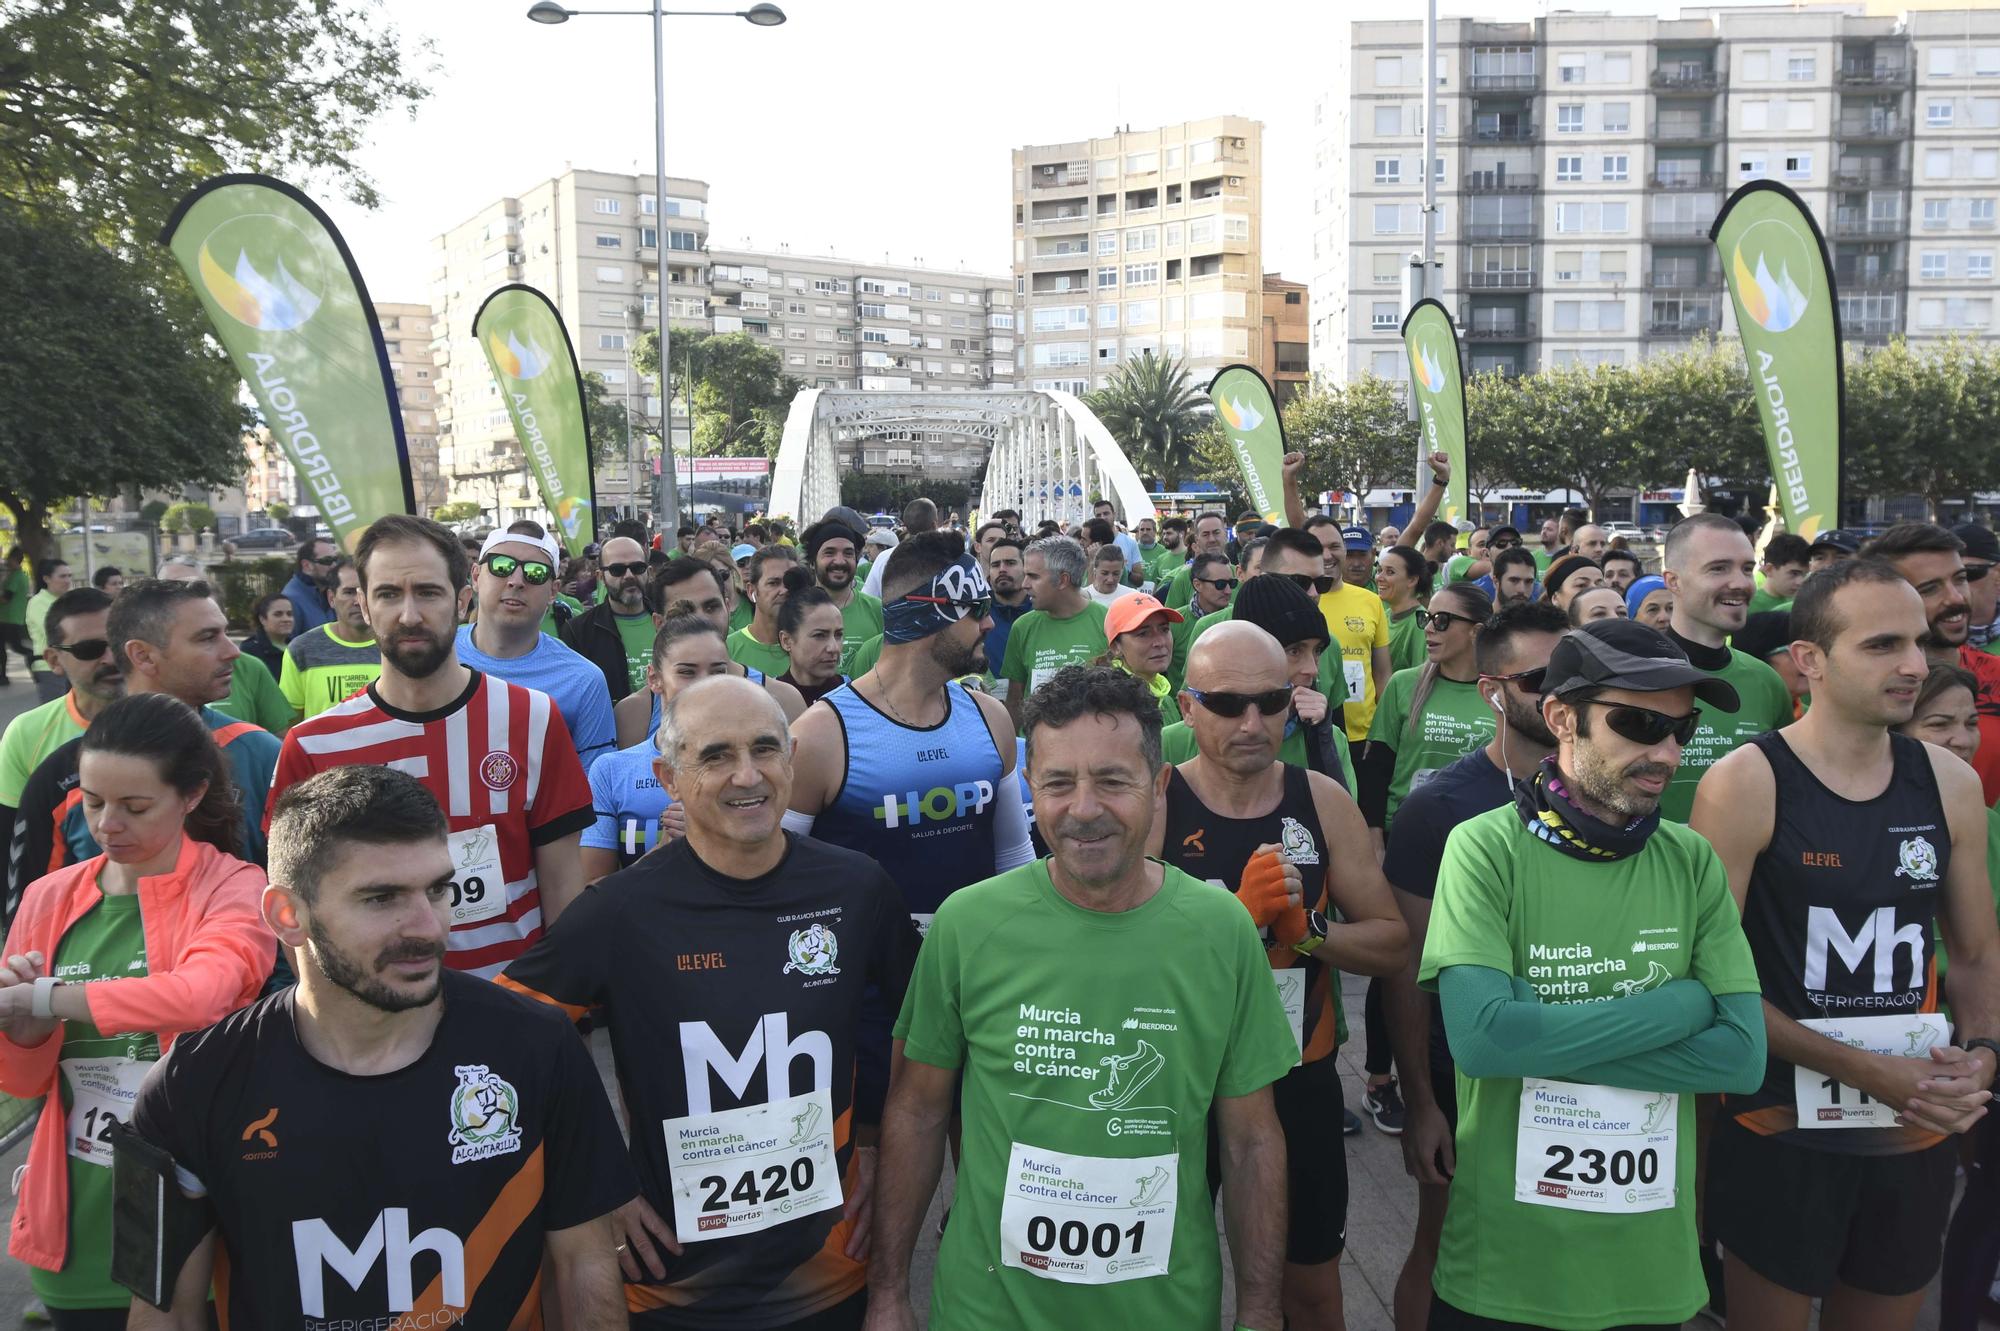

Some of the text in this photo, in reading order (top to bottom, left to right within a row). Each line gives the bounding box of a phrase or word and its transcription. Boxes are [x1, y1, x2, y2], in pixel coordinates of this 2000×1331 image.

[1426, 712, 1455, 722] Murcia
[1438, 721, 1472, 730] marcha
[1424, 727, 1454, 735] contra
[1695, 725, 1714, 735] rcia
[1434, 735, 1465, 744] cáncer
[1695, 735, 1733, 745] marcha
[916, 748, 950, 763] ULEVEL
[873, 780, 994, 829] HOPP
[911, 829, 936, 839] SALUD
[942, 823, 974, 835] DEPORTE
[1802, 851, 1843, 868] ULEVEL
[1529, 942, 1593, 960] Murcia
[1803, 905, 1925, 993] Mh
[56, 961, 91, 977] urcia
[676, 952, 727, 971] ULEVEL
[1528, 957, 1627, 978] en marcha
[1019, 1003, 1081, 1025] Murcia
[1016, 1025, 1116, 1046] en marcha
[1139, 1022, 1178, 1032] IBERDROLA
[1014, 1042, 1076, 1060] contra
[678, 1011, 833, 1117] Mh
[1013, 1058, 1100, 1081] el cáncer
[1535, 1090, 1578, 1106] Murcia
[1534, 1105, 1601, 1119] en marcha
[679, 1125, 720, 1139] Murcia
[1533, 1115, 1631, 1131] contra el cáncer
[455, 1139, 517, 1161] ALCANTARILLA
[681, 1133, 745, 1150] en marcha
[682, 1136, 778, 1161] contra el cáncer
[1022, 1157, 1062, 1176] Murcia
[1543, 1144, 1658, 1186] 2300
[699, 1156, 815, 1213] 2420
[1020, 1171, 1085, 1190] en marcha
[1019, 1182, 1118, 1204] contra el cáncer
[1538, 1184, 1605, 1199] grupohuertas
[700, 1210, 761, 1229] grupohuertas
[1027, 1215, 1145, 1259] 0001
[292, 1207, 465, 1319] Mh
[1021, 1254, 1085, 1271] grupohuertas
